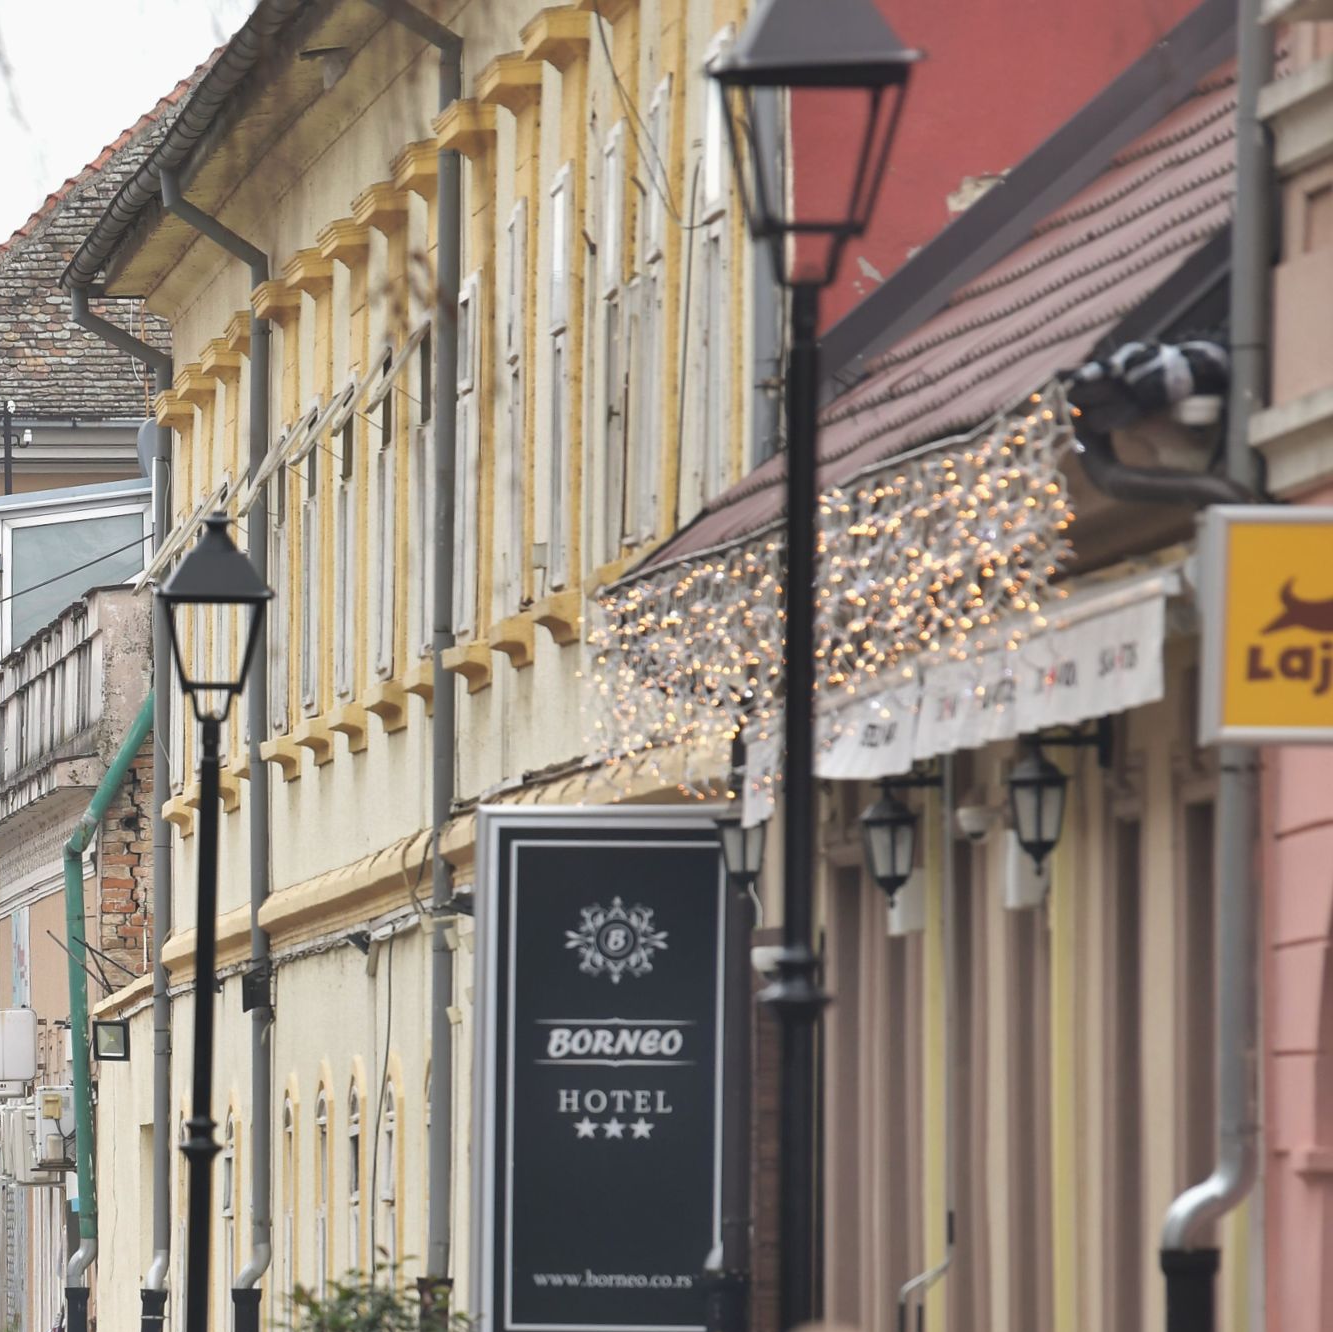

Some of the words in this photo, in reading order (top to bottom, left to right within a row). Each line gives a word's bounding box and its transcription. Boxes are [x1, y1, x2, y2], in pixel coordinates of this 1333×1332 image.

[547, 1027, 684, 1058] BORNEO
[557, 1089, 673, 1114] HOTEL
[533, 1268, 693, 1288] www.borneo.co.rs
